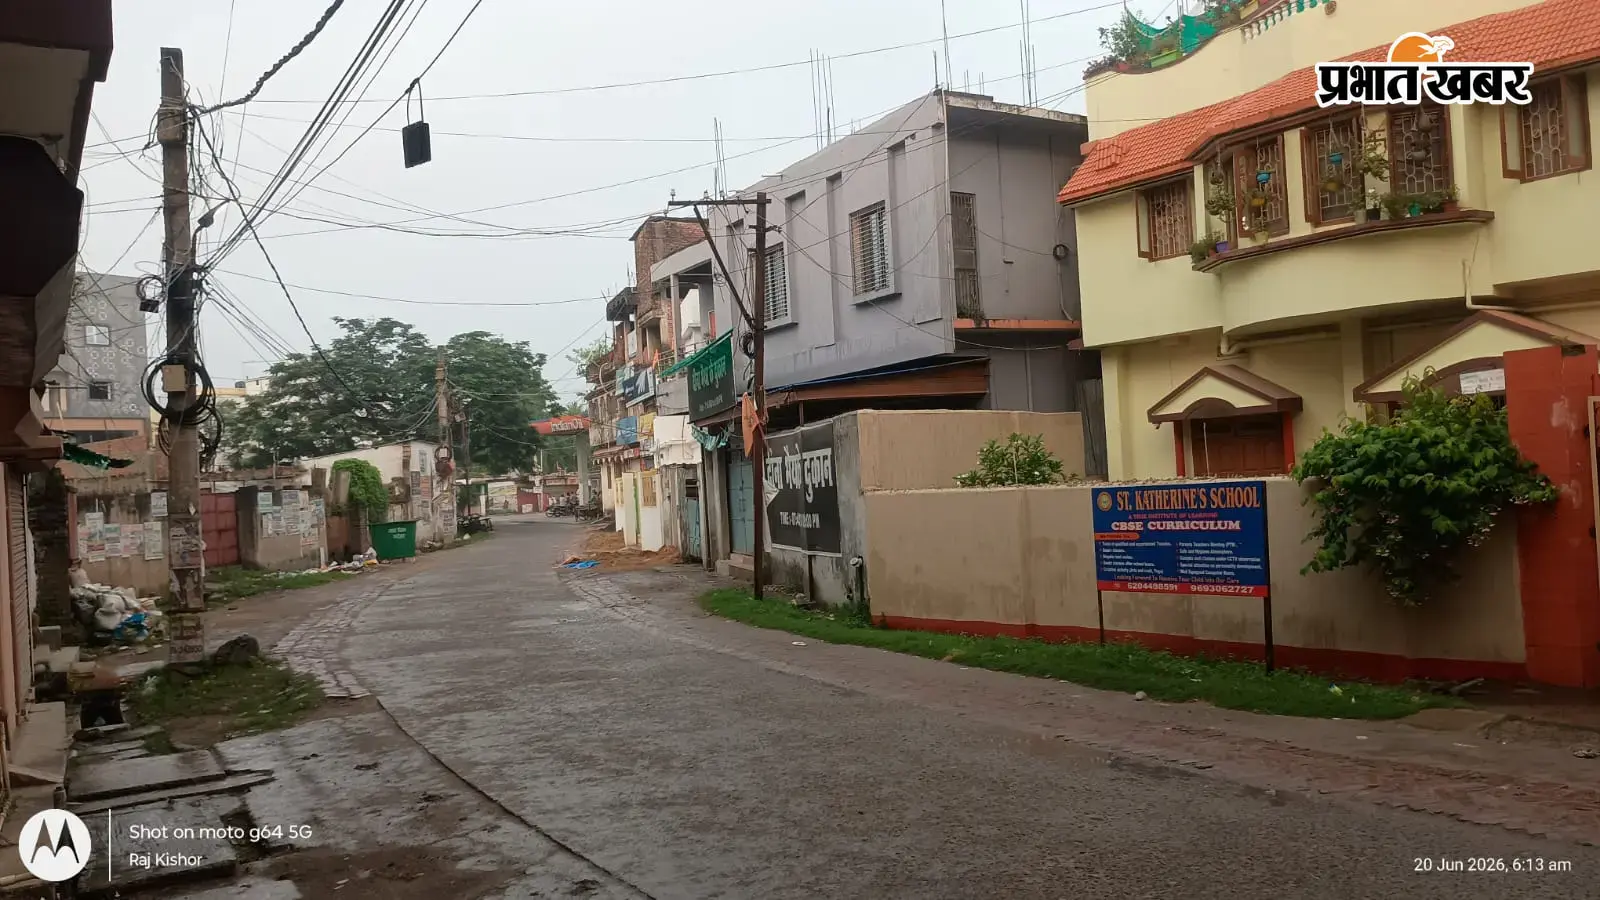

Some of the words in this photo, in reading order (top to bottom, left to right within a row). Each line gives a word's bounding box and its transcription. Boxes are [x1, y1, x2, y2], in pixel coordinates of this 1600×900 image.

[802, 447, 834, 503] दुकान
[1116, 491, 1132, 511] ST.
[1135, 487, 1207, 511] KATHERINE'S
[1210, 486, 1260, 509] SCHOOL
[1111, 521, 1143, 531] CBSE
[1147, 520, 1240, 531] CURRICULUM
[1190, 584, 1255, 593] 9693062727
